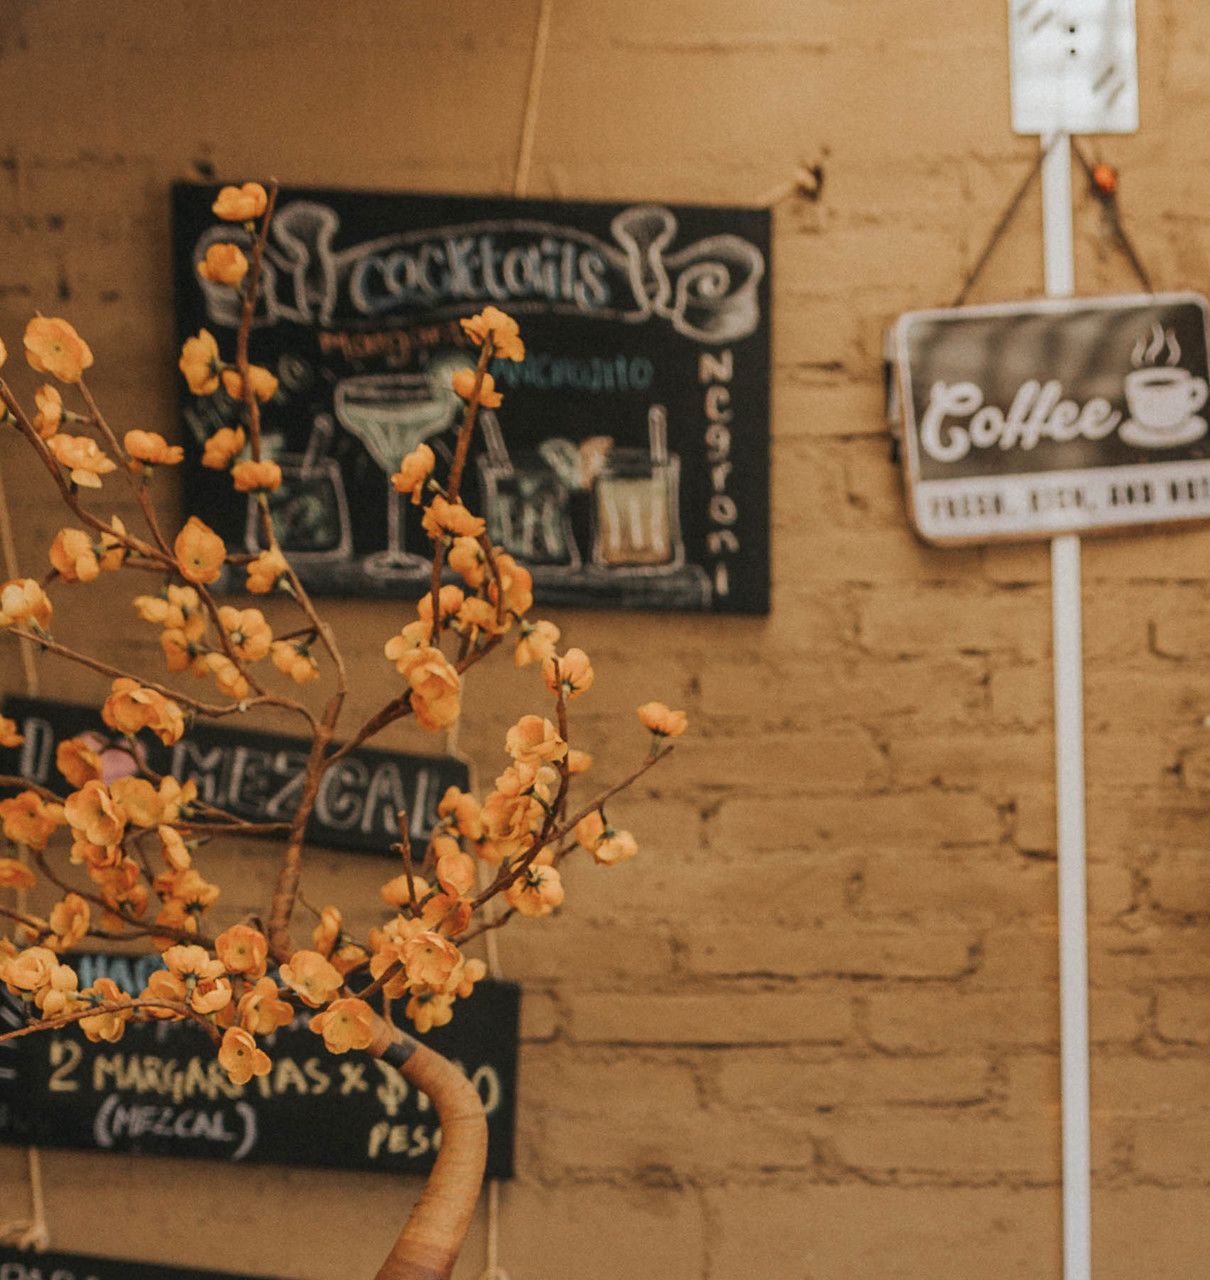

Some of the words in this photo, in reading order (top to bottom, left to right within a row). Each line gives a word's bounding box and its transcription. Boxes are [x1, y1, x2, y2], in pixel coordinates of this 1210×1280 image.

[352, 236, 608, 315] Cocktails
[921, 379, 1122, 462] Coffee
[172, 740, 442, 839] MEZCAL
[48, 1039, 82, 1091] 2
